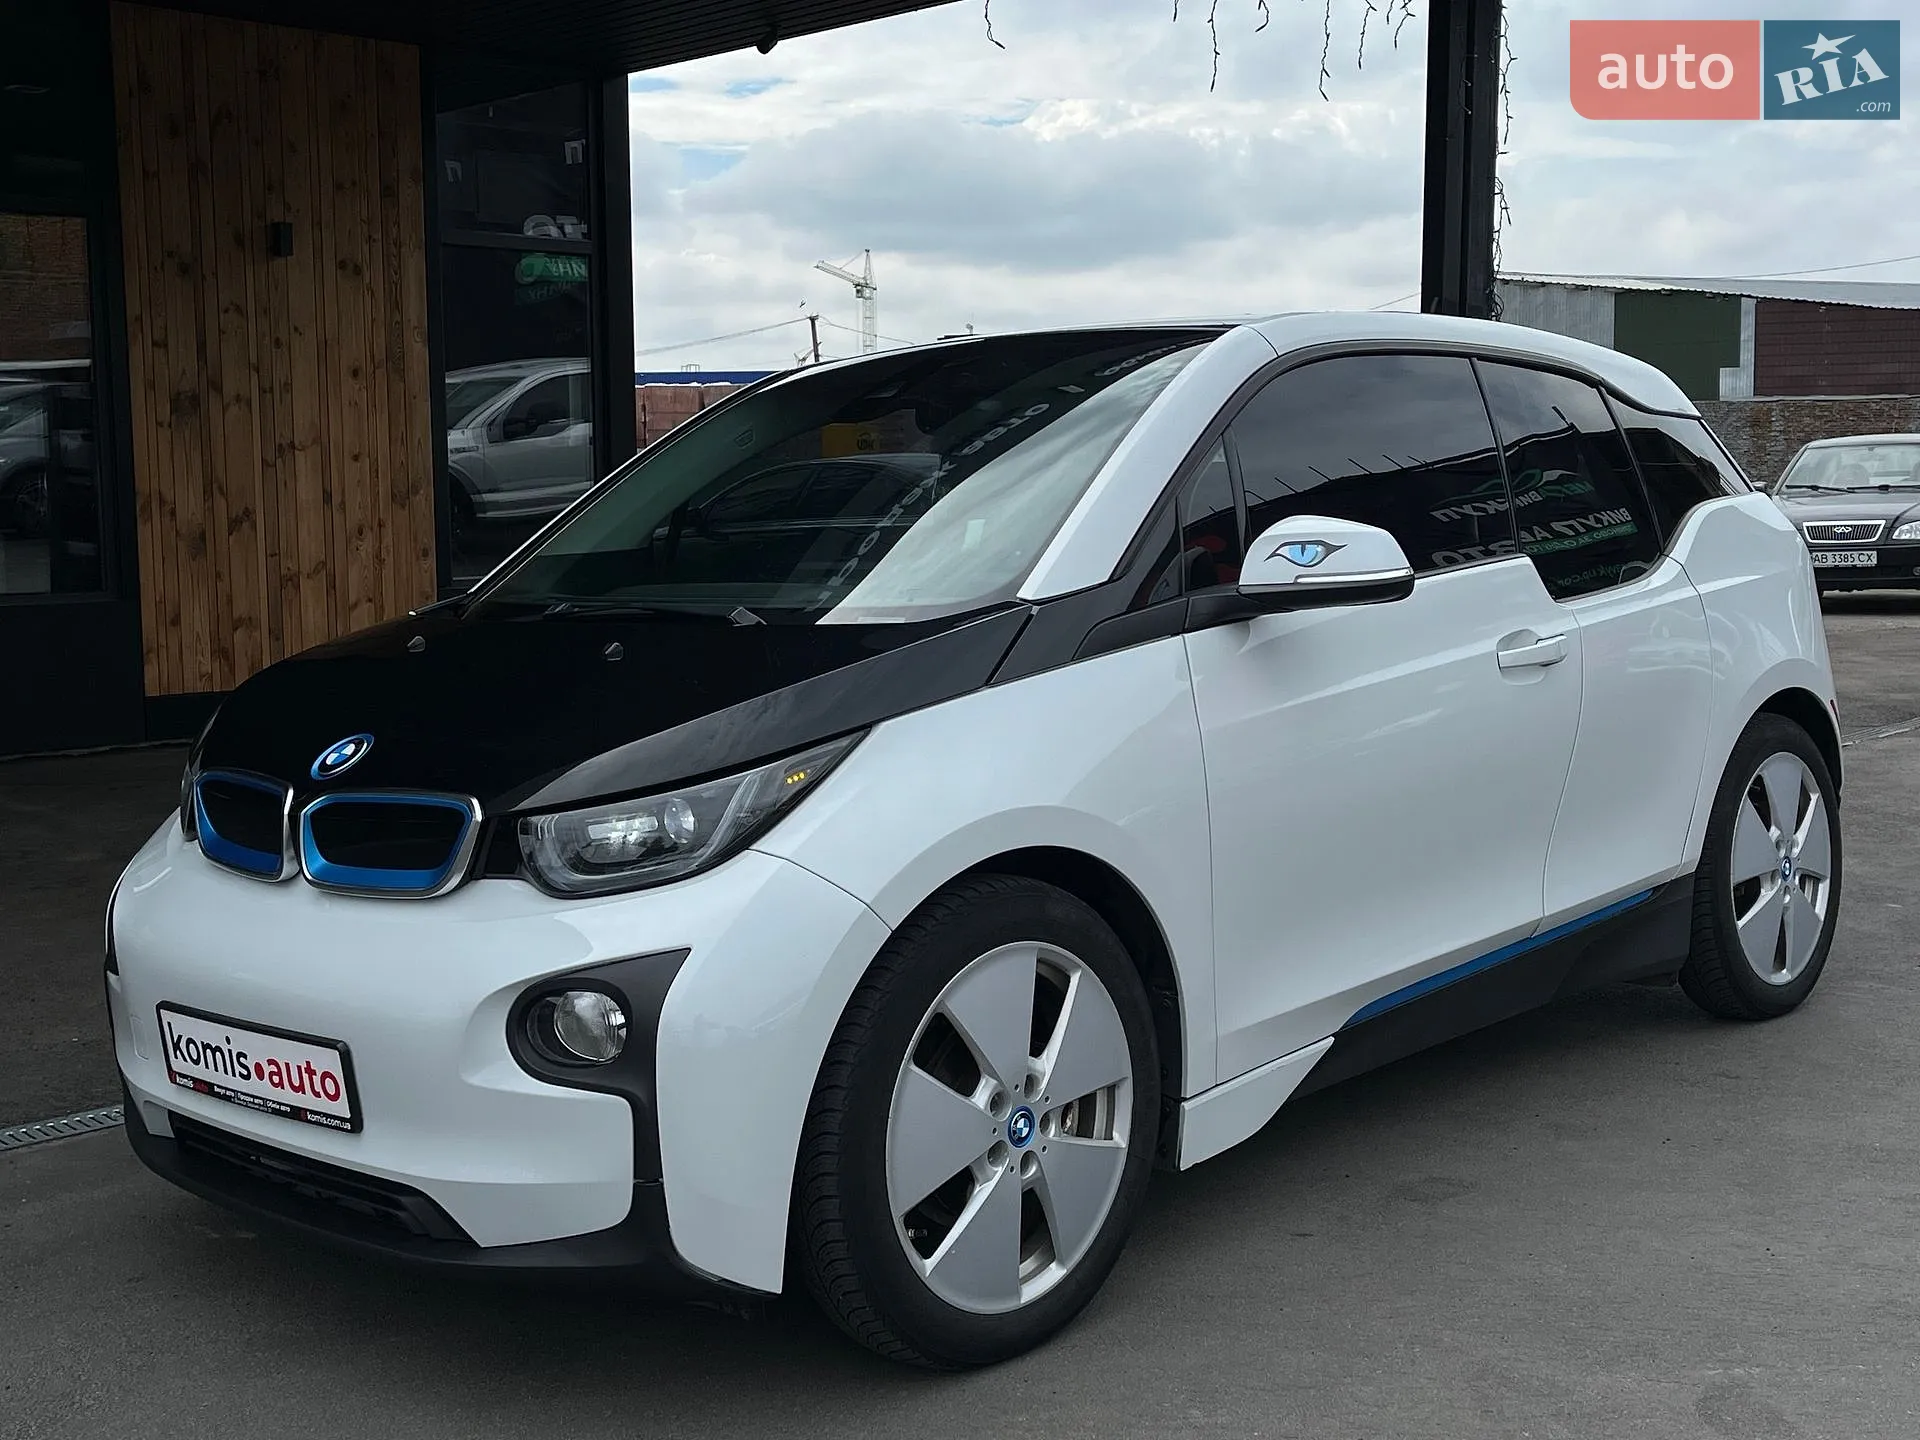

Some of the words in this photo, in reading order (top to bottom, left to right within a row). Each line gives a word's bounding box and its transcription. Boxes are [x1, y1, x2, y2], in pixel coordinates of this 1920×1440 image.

[1813, 553, 1829, 564] AB
[1831, 553, 1856, 564] 3385
[1857, 552, 1873, 563] CX
[167, 1021, 252, 1081] komis
[264, 1056, 342, 1102] auto
